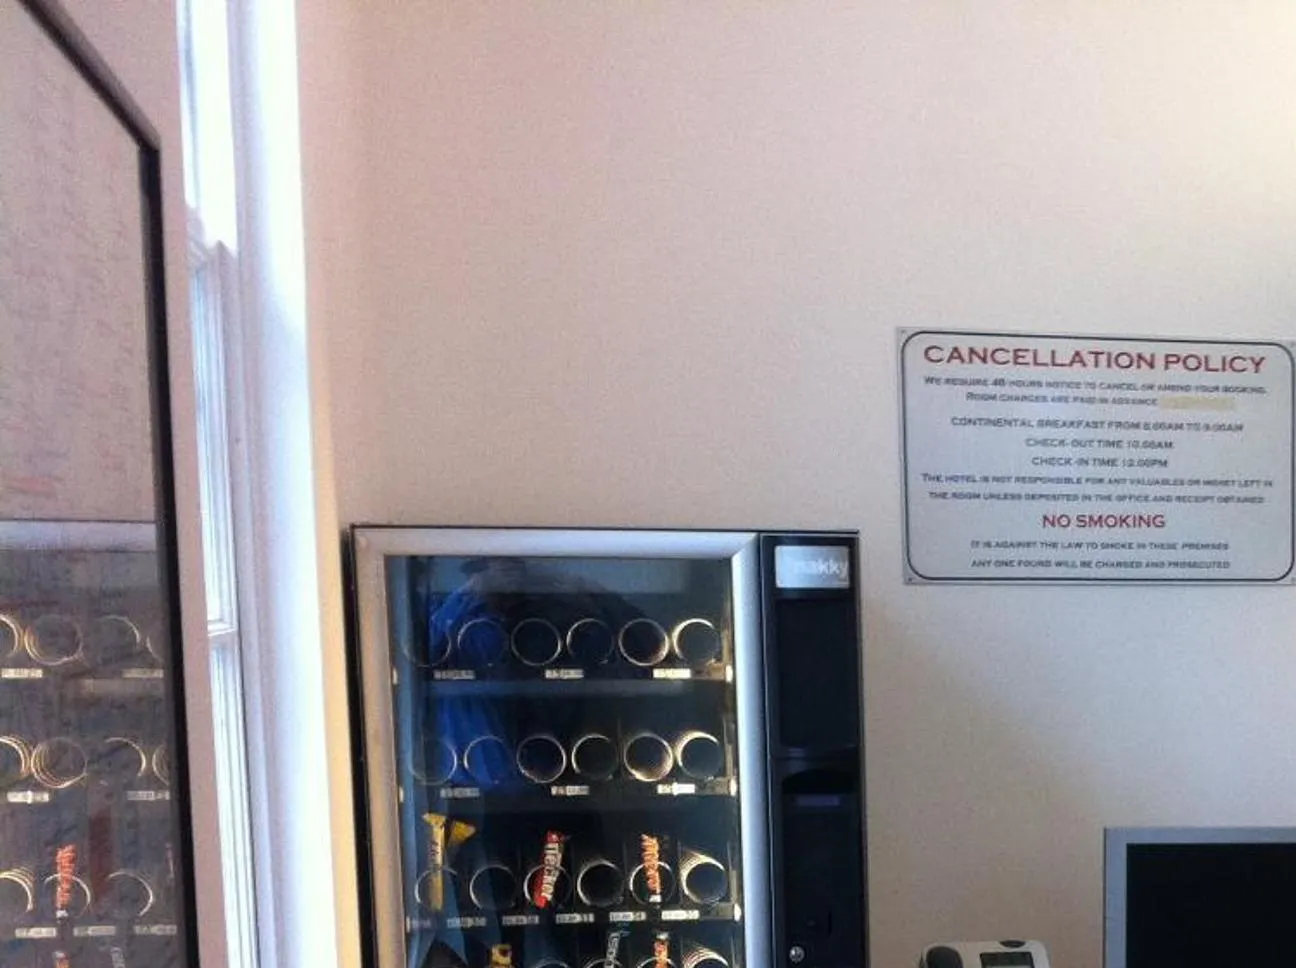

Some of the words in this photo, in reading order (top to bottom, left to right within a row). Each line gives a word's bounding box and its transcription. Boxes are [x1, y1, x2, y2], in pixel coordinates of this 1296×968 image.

[923, 345, 1155, 370] CANCELLATION
[1163, 353, 1266, 374] POLICY
[1099, 382, 1139, 392] CANCEL
[951, 416, 1034, 428] CONTINENTAL
[1036, 418, 1105, 430] BREAKFAST
[1107, 420, 1141, 431] FROM
[1097, 438, 1123, 449] TIME
[1093, 458, 1119, 468] TIME
[945, 474, 977, 484] HOTEL
[1042, 514, 1071, 528] NO
[1075, 514, 1166, 529] SMOKING
